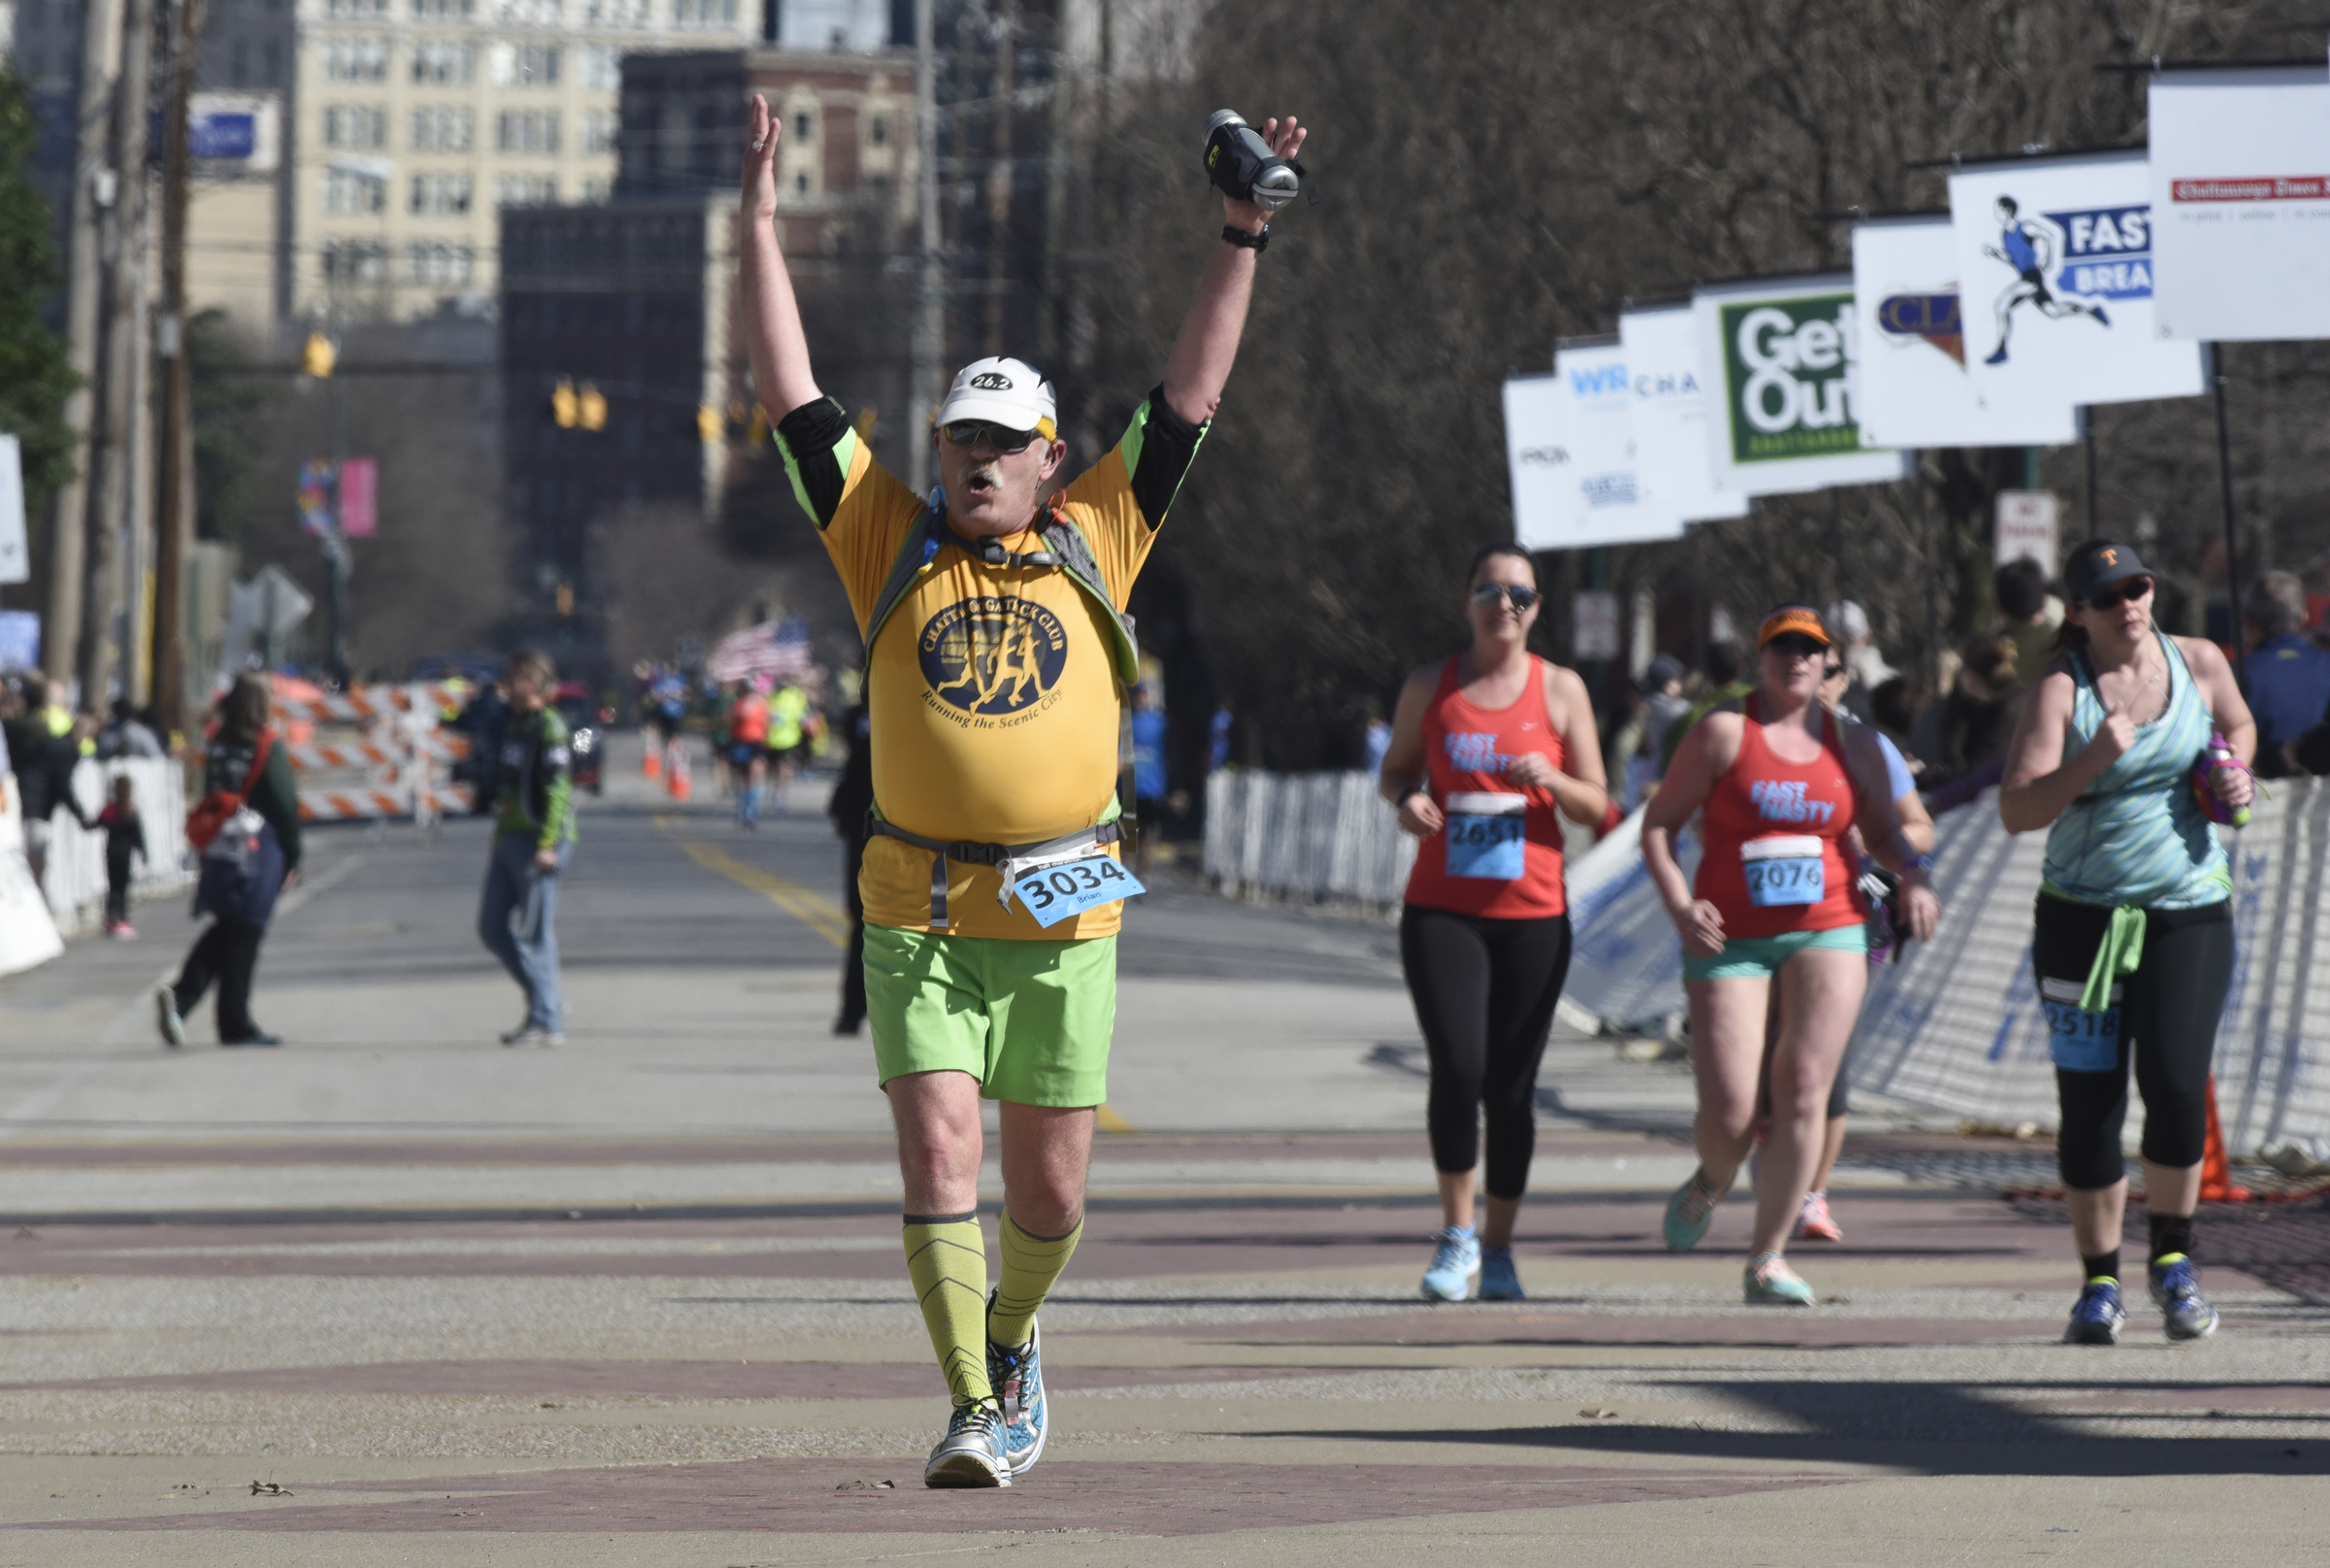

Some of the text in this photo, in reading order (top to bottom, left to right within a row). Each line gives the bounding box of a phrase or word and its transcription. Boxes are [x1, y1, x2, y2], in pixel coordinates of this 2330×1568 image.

[2069, 210, 2150, 253] FAS
[1738, 303, 1857, 373] Get
[973, 375, 1011, 389] 26.2
[1742, 365, 1861, 432] Out
[2100, 549, 2118, 567] T
[1038, 613, 1064, 651] CLUB
[922, 686, 1063, 729] Running the Scenic City
[1445, 731, 1499, 755] FAST
[1750, 780, 1810, 804] FAST
[1758, 797, 1837, 824] NASTY
[1022, 861, 1126, 910] 3034
[1748, 863, 1821, 891] 2076
[1077, 891, 1101, 904] Brian
[2047, 1008, 2116, 1037] 2518
